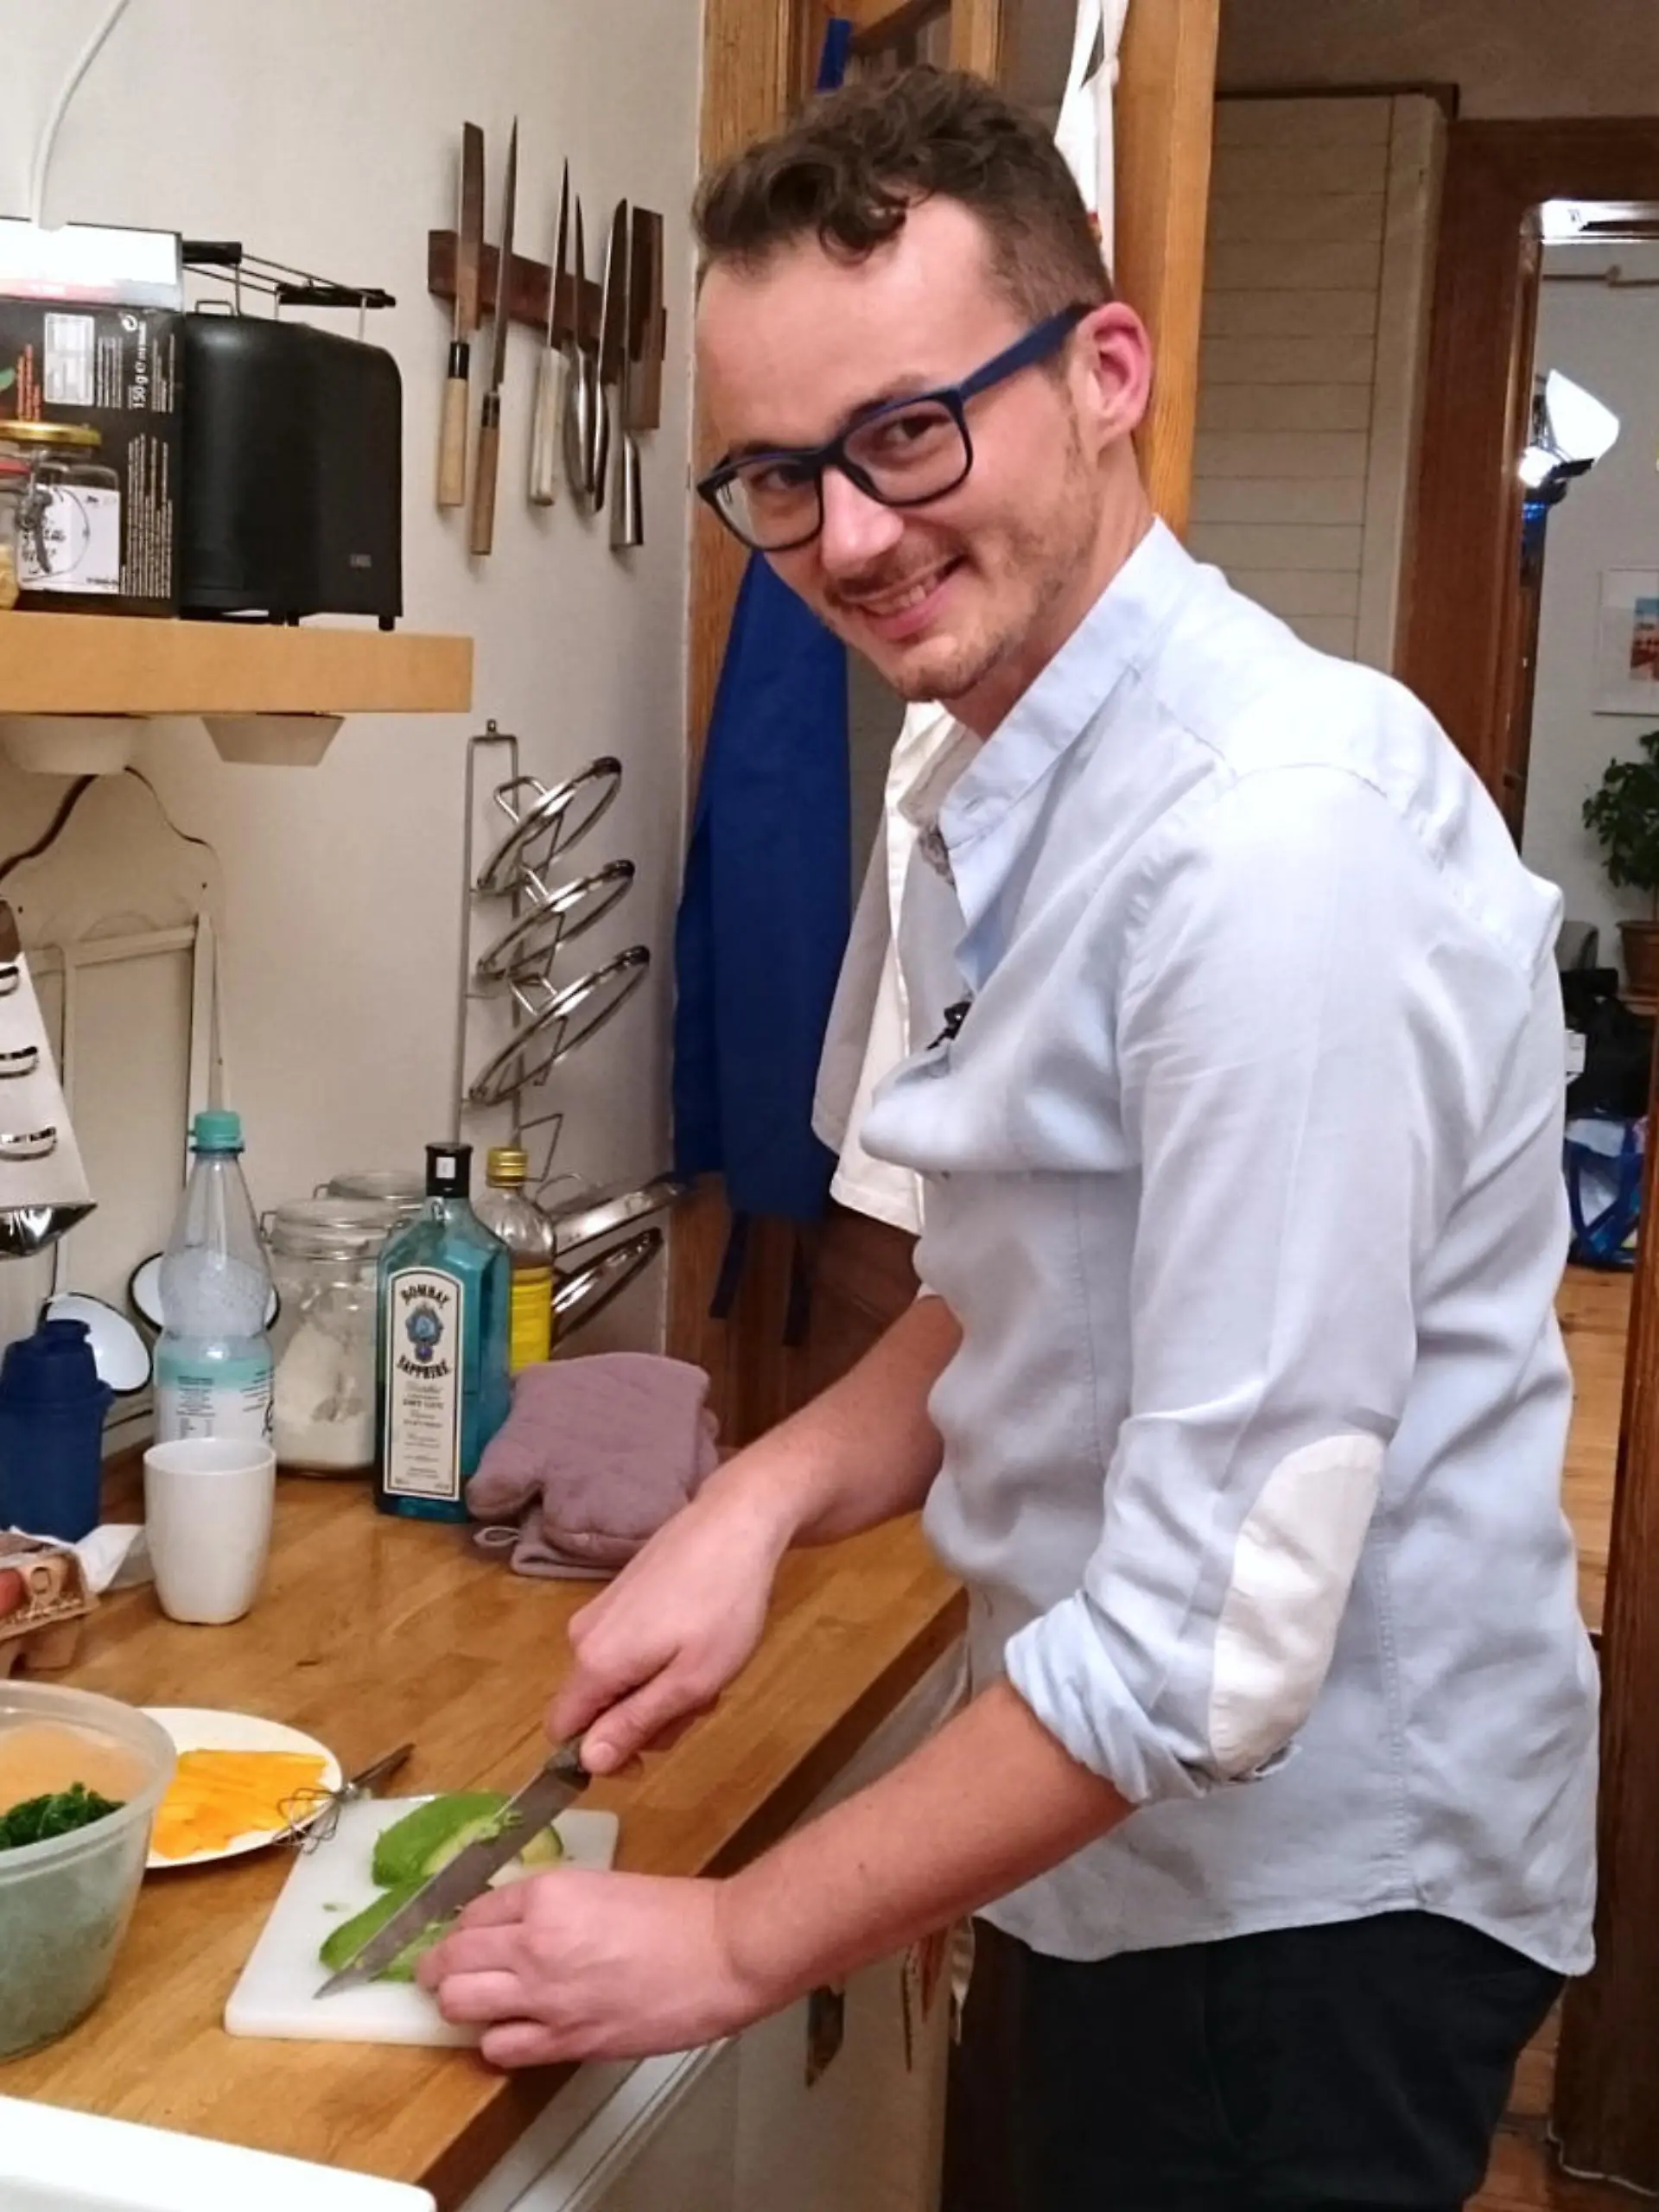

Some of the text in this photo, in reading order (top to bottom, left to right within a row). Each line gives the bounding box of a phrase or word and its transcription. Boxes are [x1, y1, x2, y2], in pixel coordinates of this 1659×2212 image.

[132, 385, 146, 408] 150
[400, 1284, 450, 1309] BOMBAY
[397, 1353, 451, 1379] SAPPHIRE
